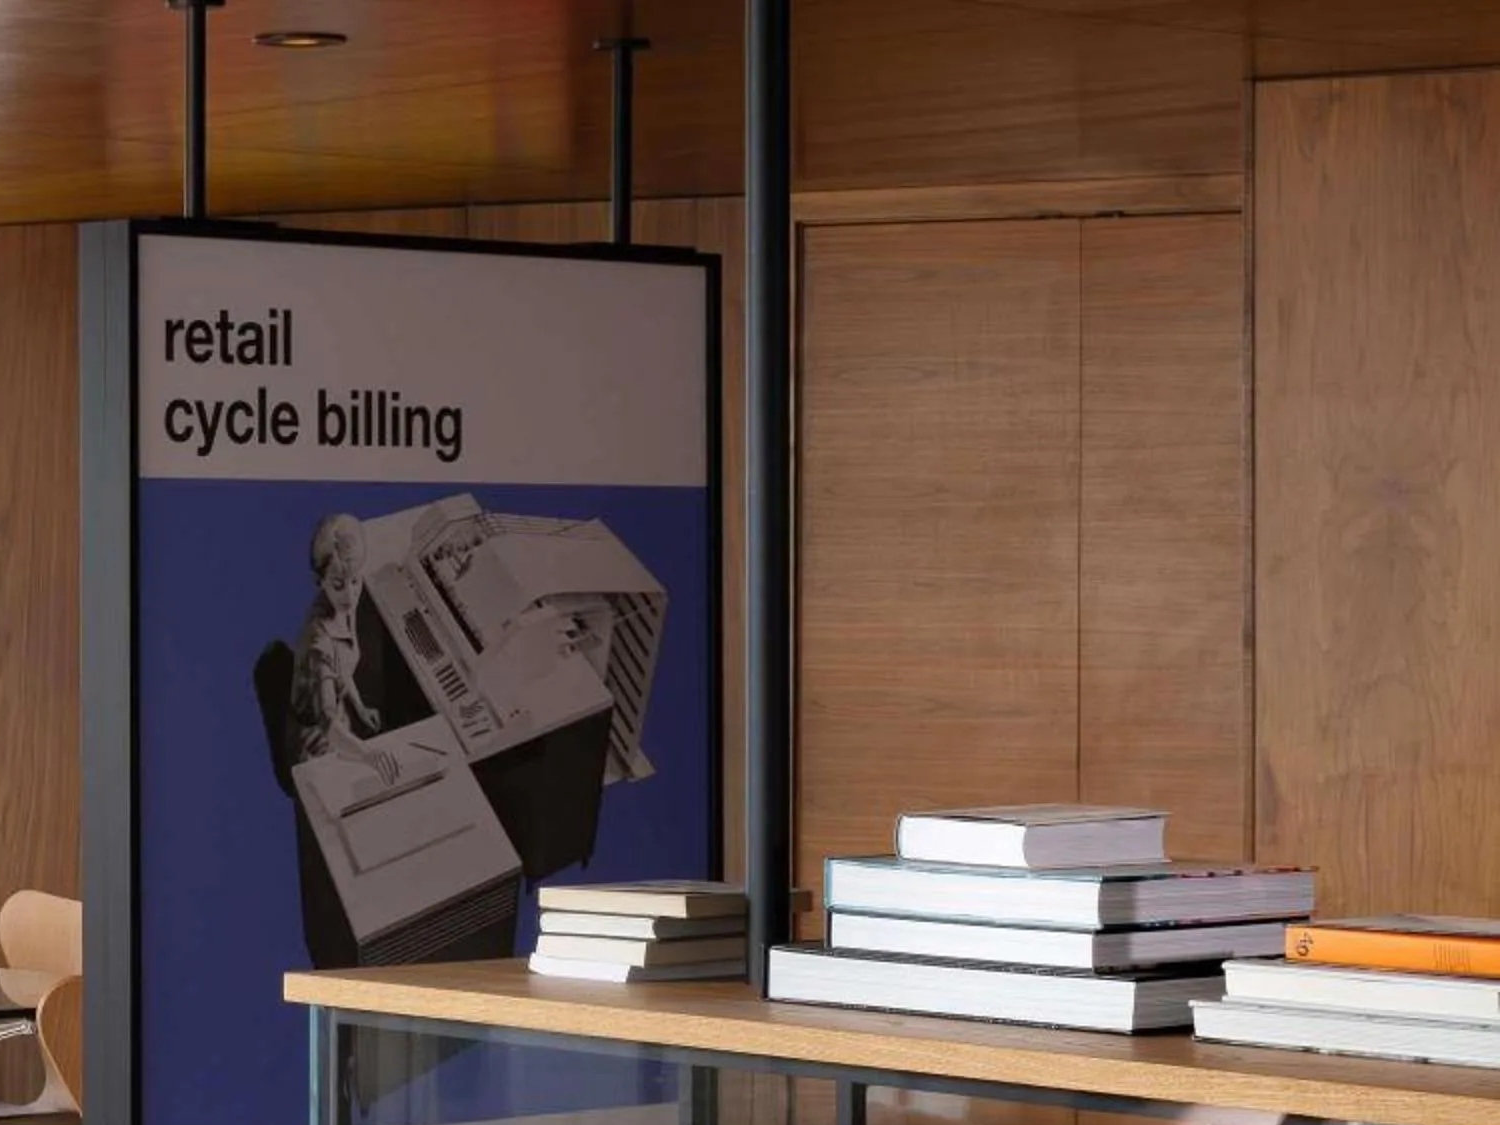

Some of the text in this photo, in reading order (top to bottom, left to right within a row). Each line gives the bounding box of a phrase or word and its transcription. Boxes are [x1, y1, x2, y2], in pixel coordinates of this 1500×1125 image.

[164, 307, 293, 366] retail
[164, 386, 462, 463] cycle billing
